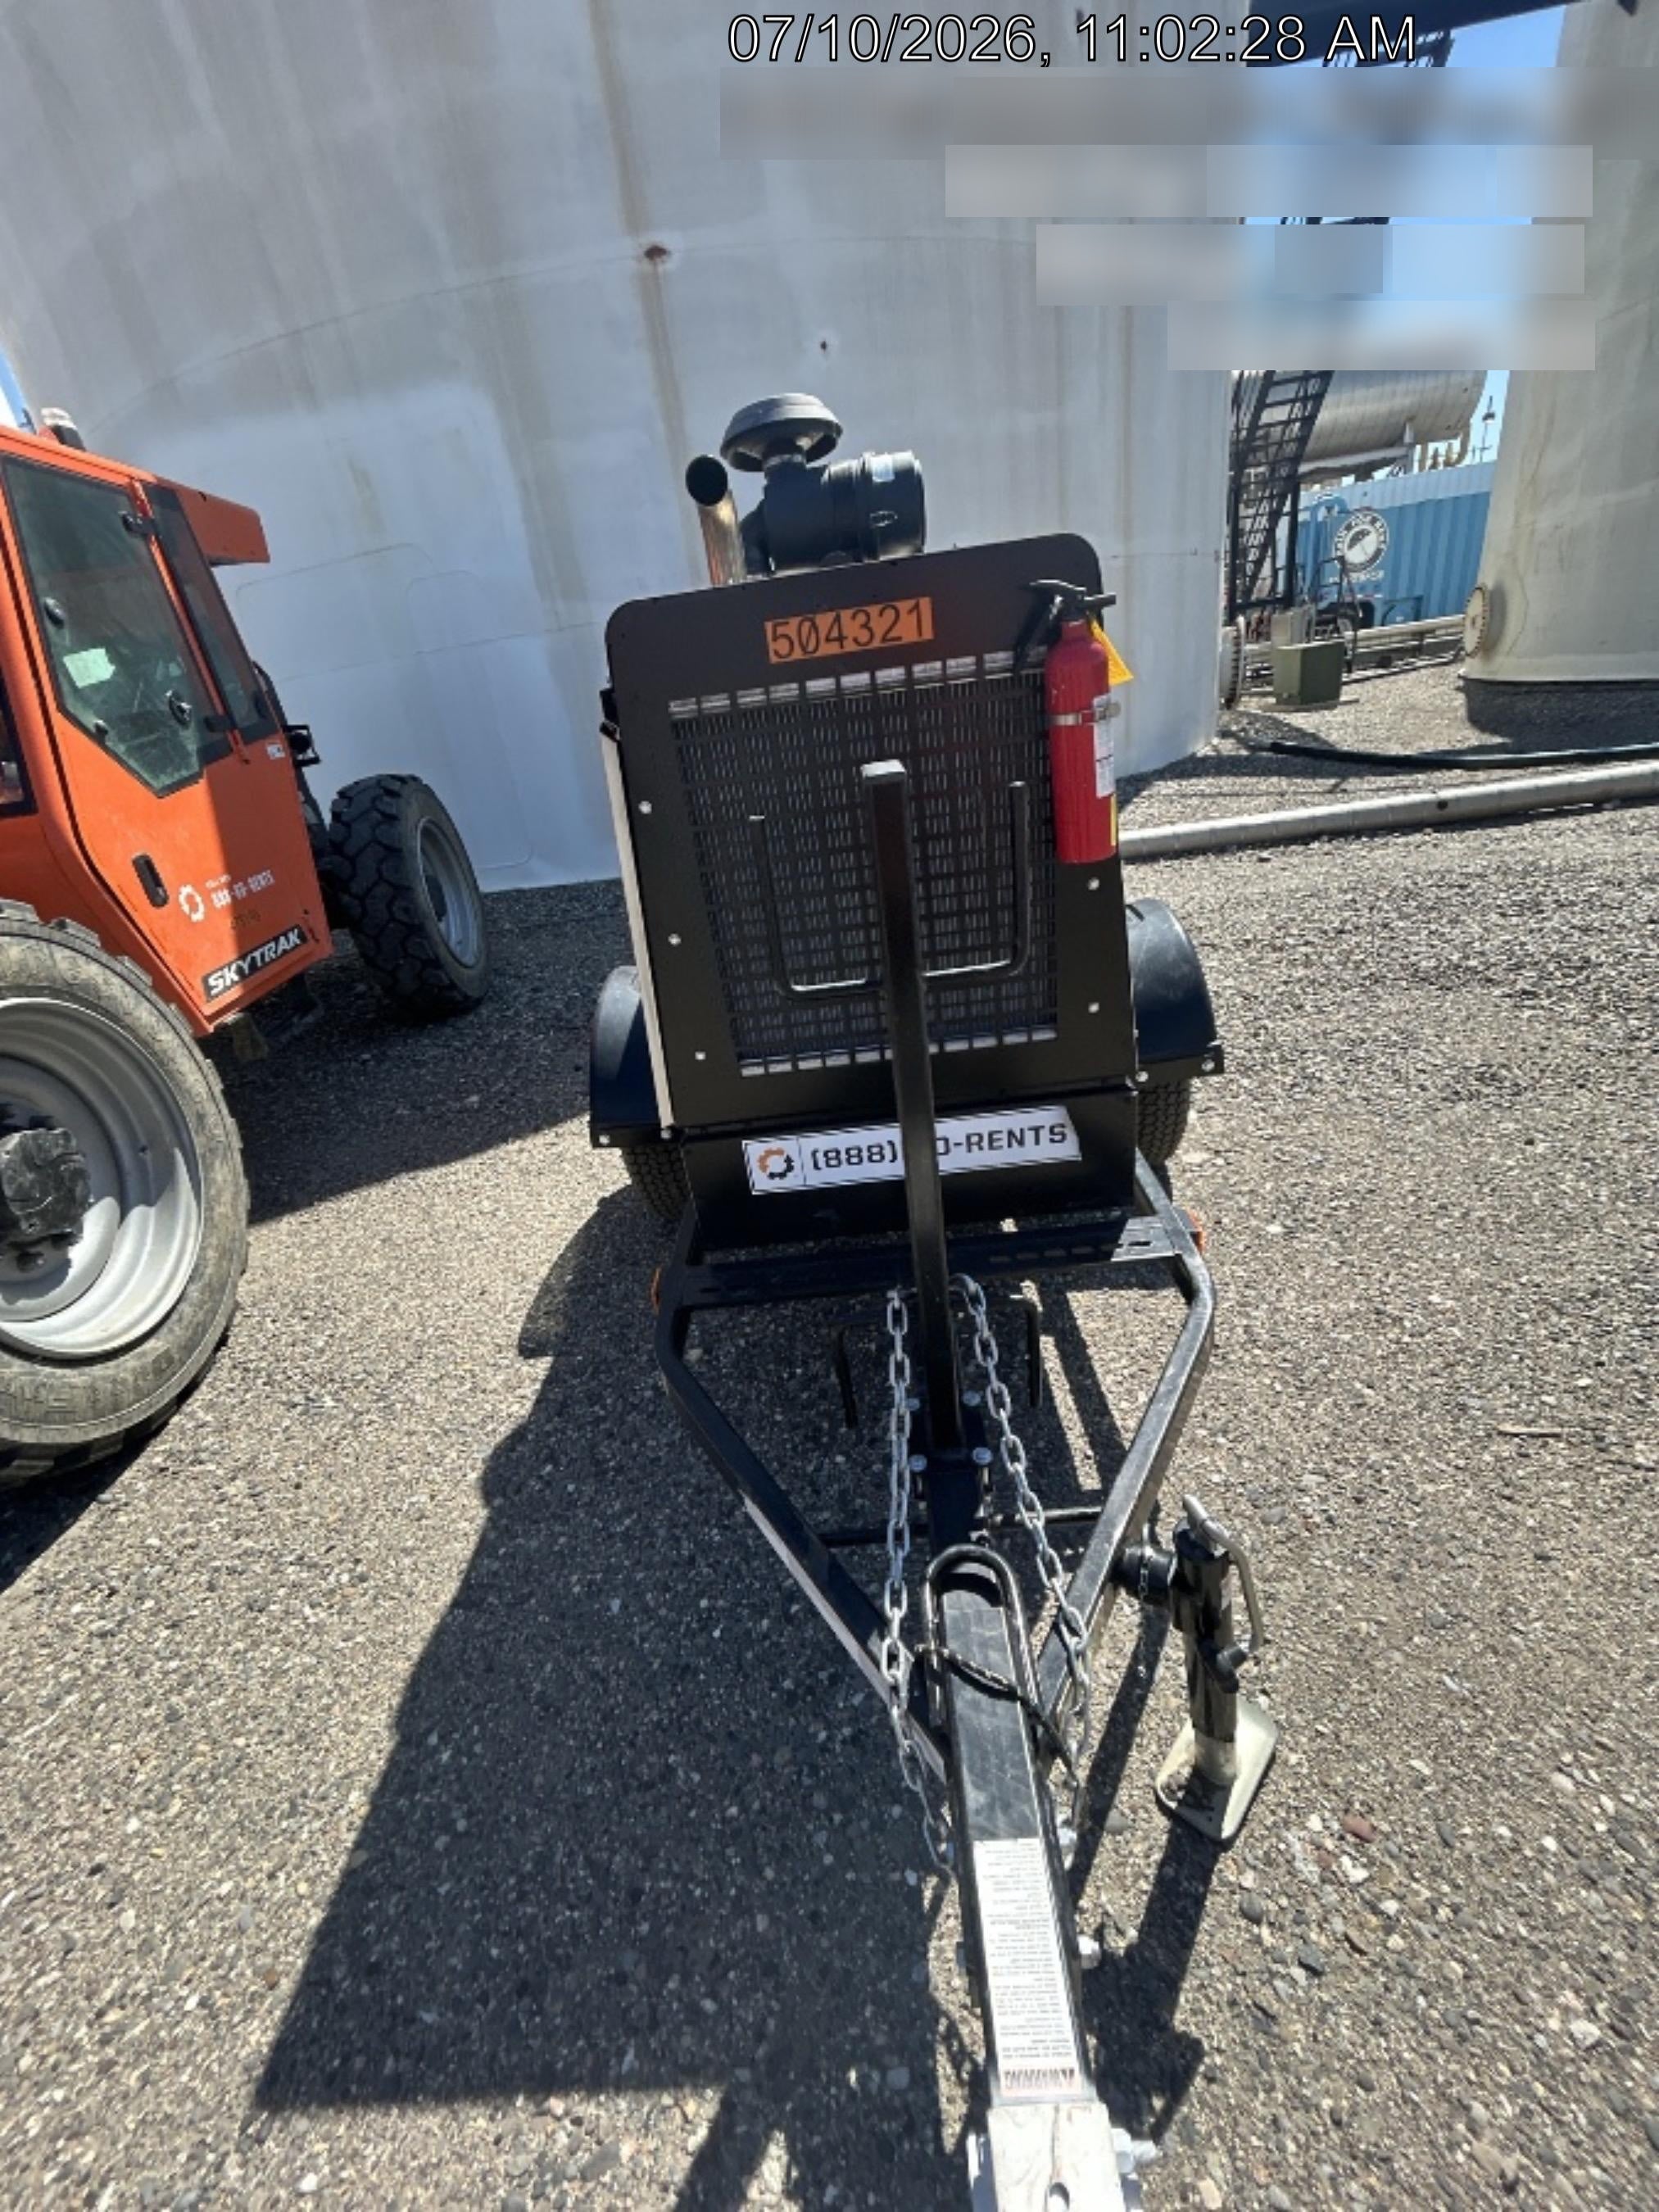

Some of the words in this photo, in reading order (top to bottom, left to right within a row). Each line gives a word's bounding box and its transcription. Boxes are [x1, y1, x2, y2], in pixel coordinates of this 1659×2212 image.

[772, 599, 922, 659] 504321
[207, 928, 301, 996] SKYTRAK
[811, 1140, 898, 1172] (888)
[936, 1123, 1067, 1156] O-RENTS
